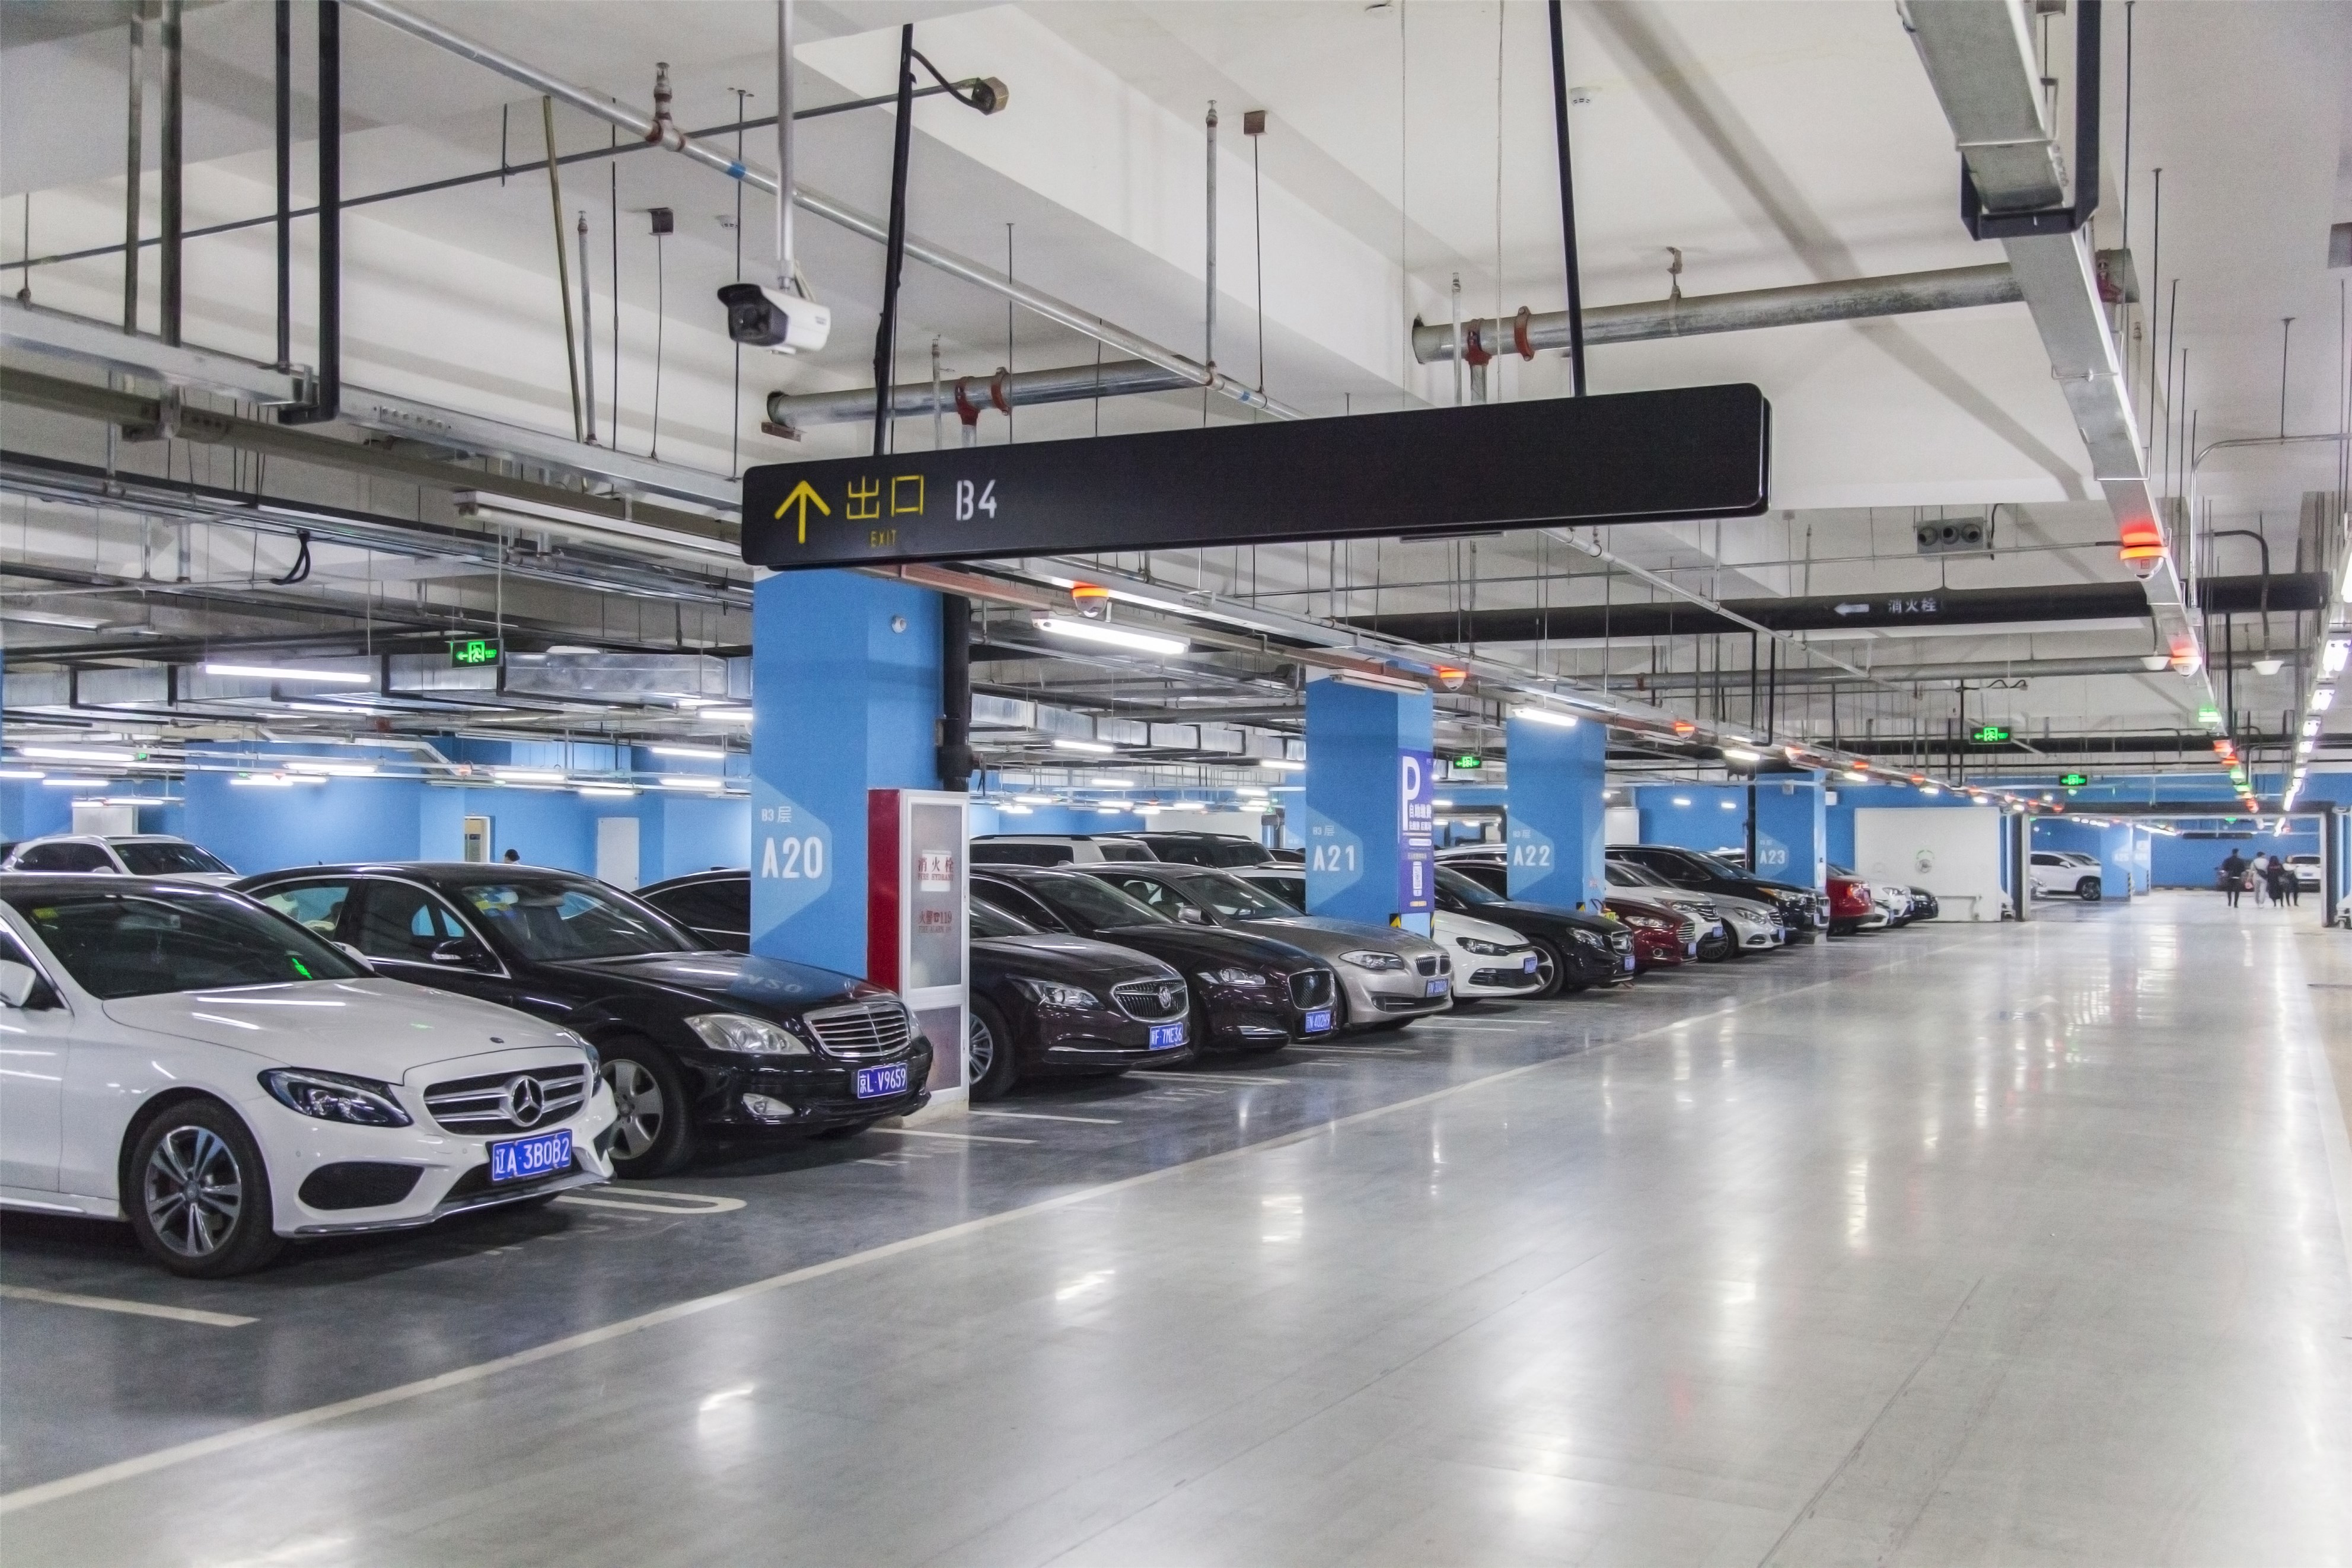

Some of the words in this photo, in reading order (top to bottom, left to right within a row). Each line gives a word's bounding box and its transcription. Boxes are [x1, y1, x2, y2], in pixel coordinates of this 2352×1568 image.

[847, 475, 923, 520] 出口
[957, 479, 997, 521] B4
[871, 530, 897, 547] EXIT
[1888, 598, 1936, 614] 消火栓
[1402, 756, 1421, 831] P
[761, 836, 823, 879] A20
[917, 856, 954, 873] 消火栓
[1312, 844, 1355, 871] A21
[1513, 844, 1550, 866] A22
[1759, 849, 1785, 864] A23
